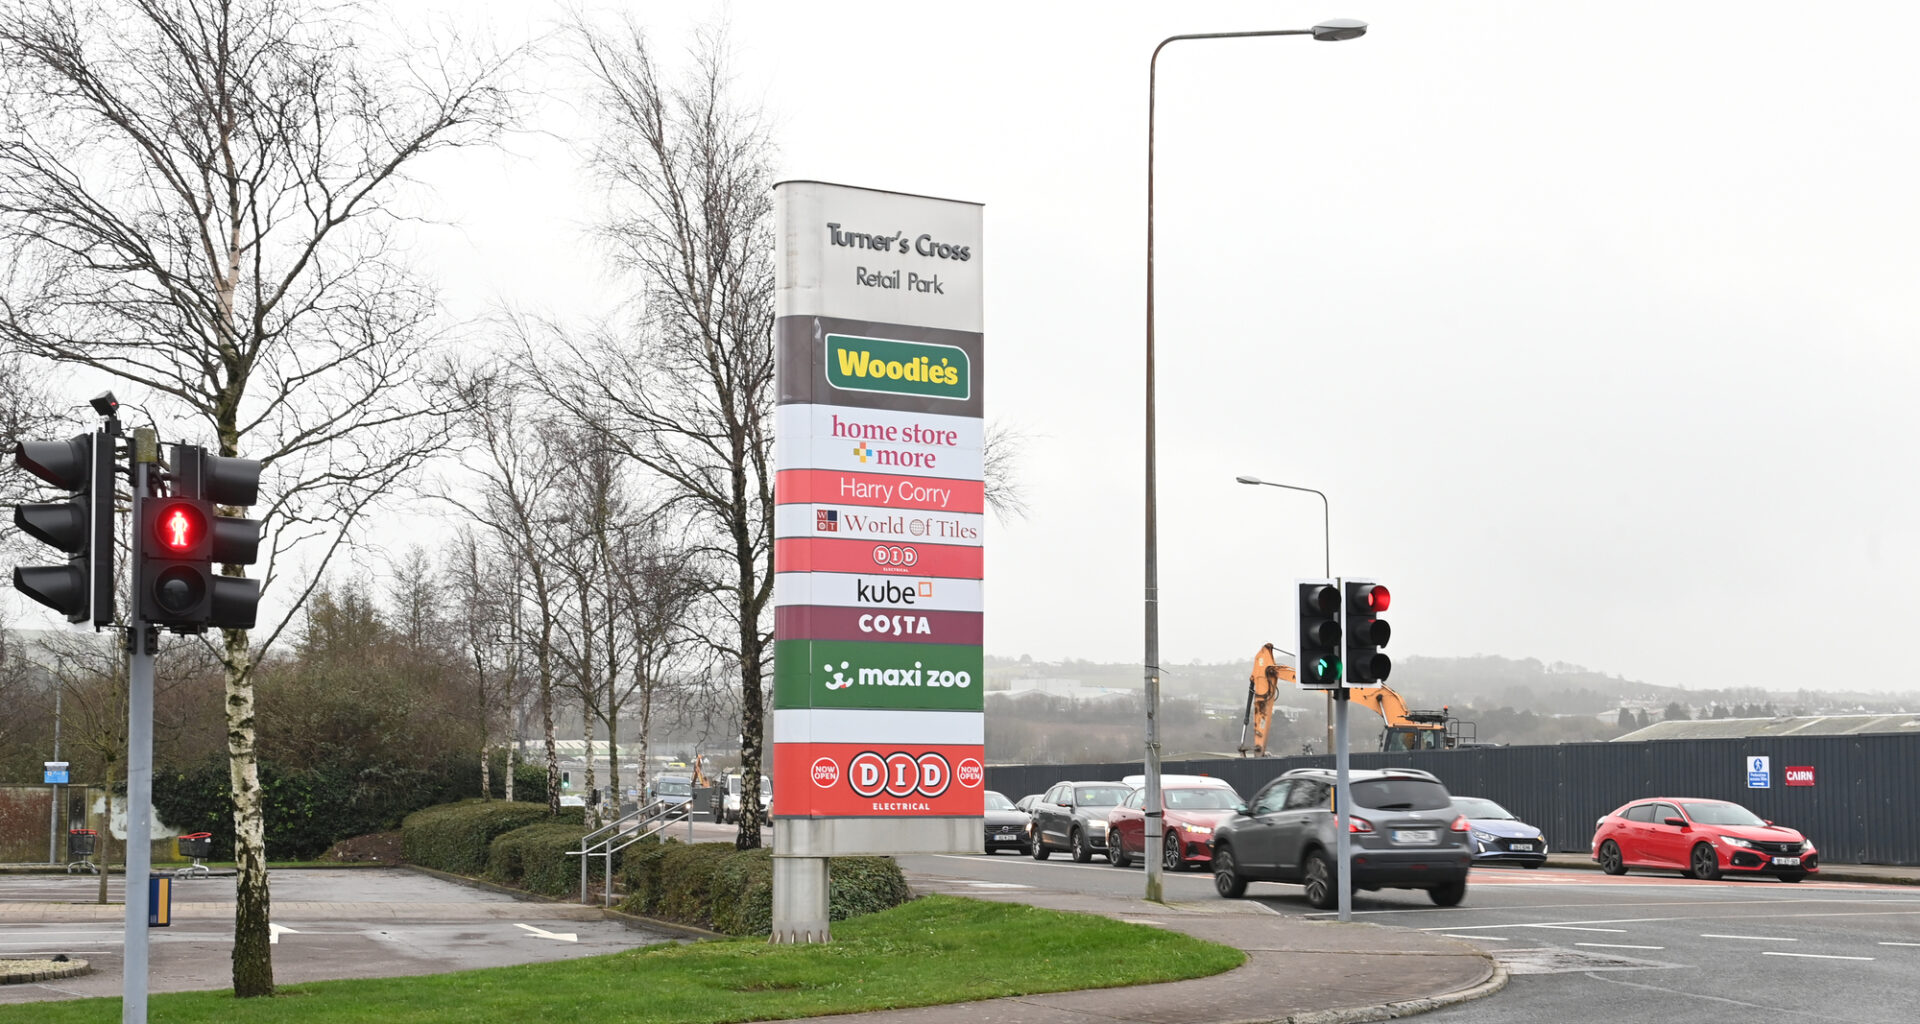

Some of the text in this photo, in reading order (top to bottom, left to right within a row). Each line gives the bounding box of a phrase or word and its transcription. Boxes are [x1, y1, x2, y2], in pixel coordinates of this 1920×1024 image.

[827, 222, 971, 261] Turner's Cross
[856, 266, 944, 294] Retail Park
[837, 348, 958, 385] Woodie's
[832, 414, 957, 446] home store
[876, 449, 936, 468] more
[841, 477, 950, 507] Harry Corry
[845, 514, 904, 534] World
[936, 520, 977, 539] Tiles
[878, 550, 914, 562] DID
[857, 579, 916, 604] kube
[858, 614, 931, 636] COSTA
[858, 661, 971, 688] maxi zoo
[859, 763, 941, 787] DID
[1786, 771, 1813, 781] CAIRN
[872, 802, 930, 811] ELECTRICAL
